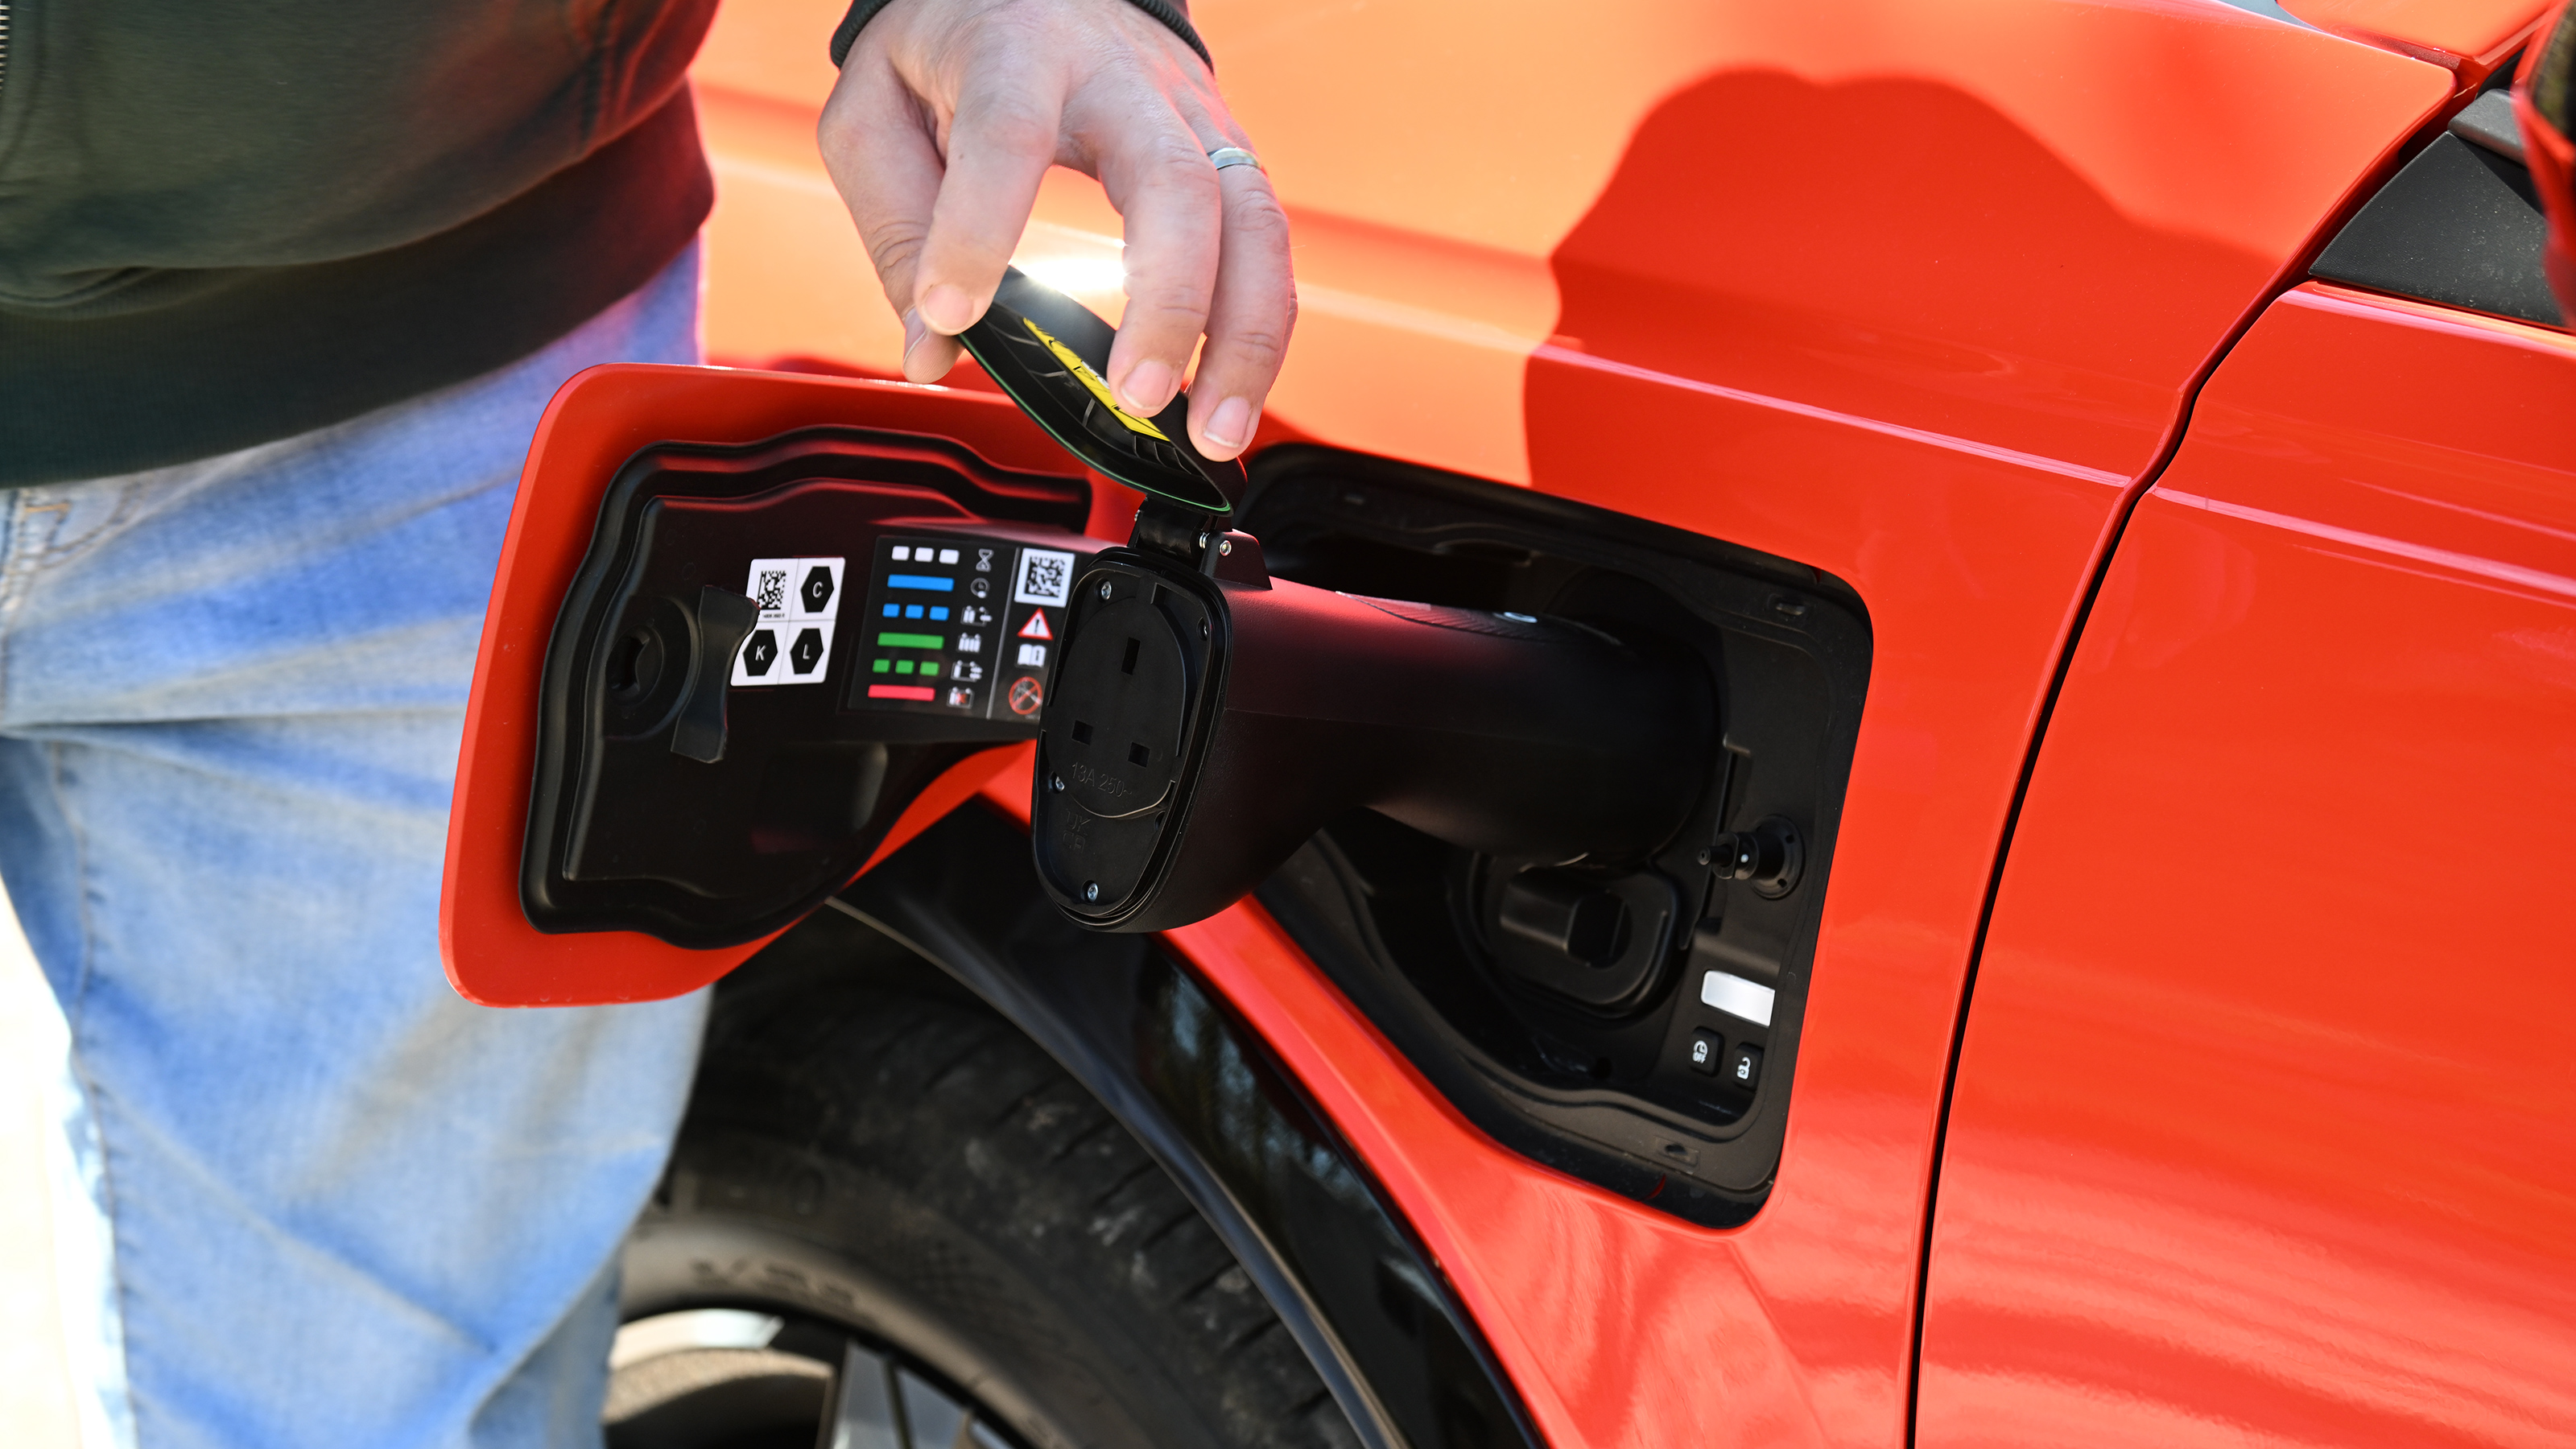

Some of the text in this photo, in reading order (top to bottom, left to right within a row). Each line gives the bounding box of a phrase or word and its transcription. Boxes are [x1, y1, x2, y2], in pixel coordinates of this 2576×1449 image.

[812, 581, 824, 598] C
[755, 645, 766, 661] K
[802, 643, 811, 659] L
[1071, 762, 1096, 787] 13A
[1066, 808, 1092, 836] UK
[1692, 1051, 1706, 1063] OFF
